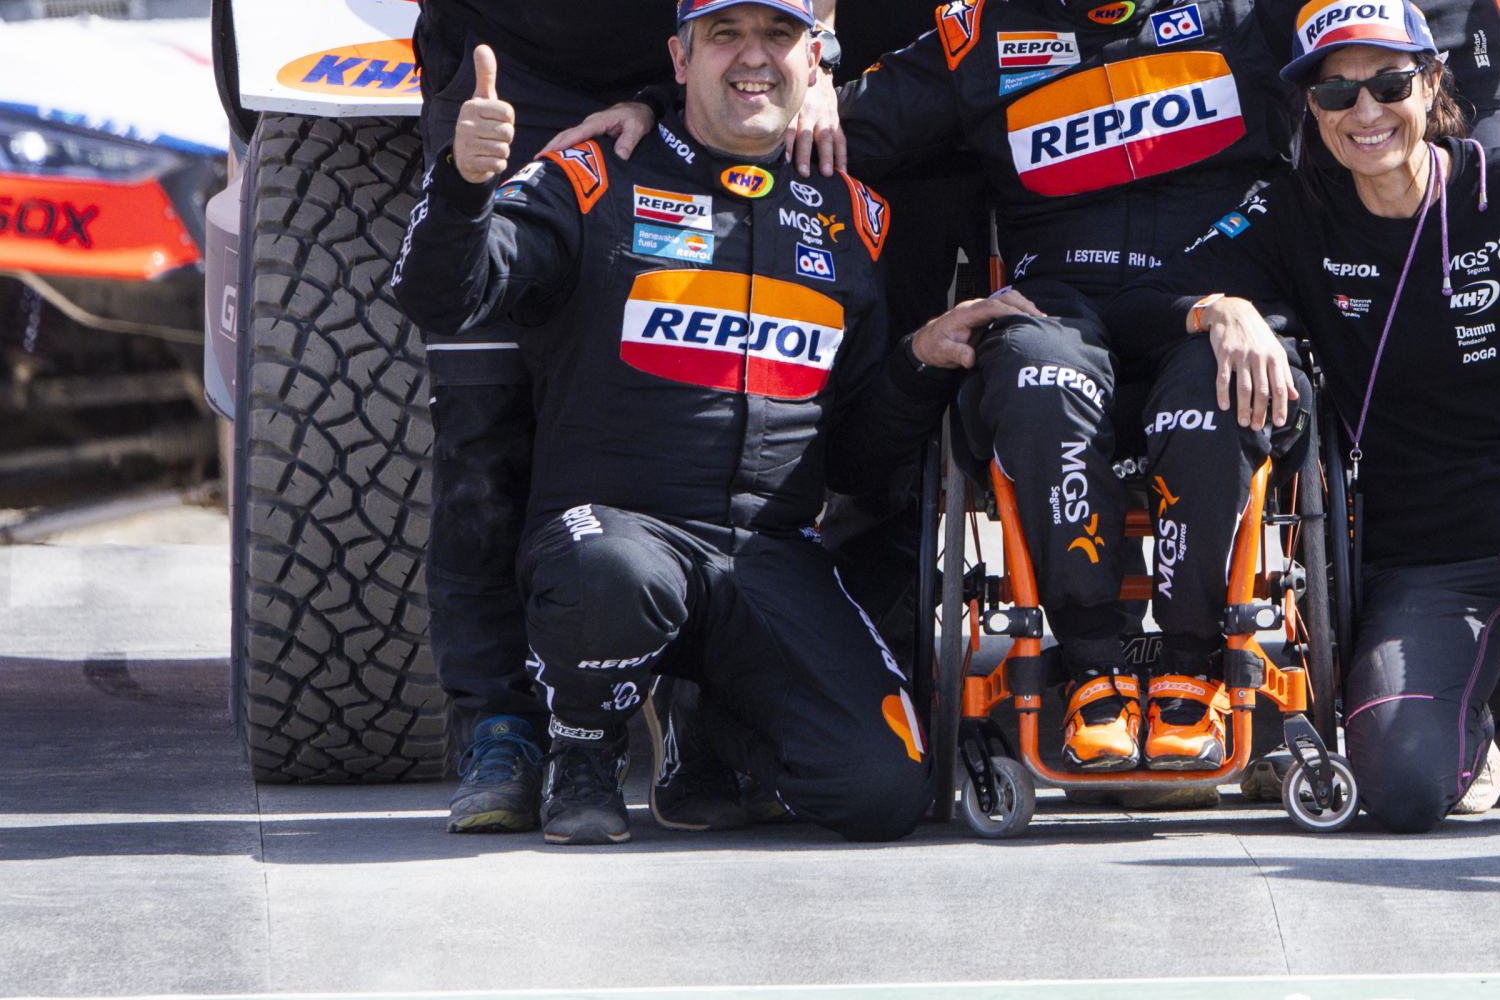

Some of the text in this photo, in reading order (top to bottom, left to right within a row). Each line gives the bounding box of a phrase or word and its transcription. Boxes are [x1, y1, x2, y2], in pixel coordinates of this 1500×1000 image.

[1306, 4, 1390, 45] REPSOL
[1003, 42, 1073, 54] REPSOL
[301, 54, 421, 93] KH-
[1030, 88, 1217, 164] REPSOL
[638, 196, 706, 217] REPSOL
[779, 208, 823, 237] MGS
[638, 239, 658, 249] fuels
[639, 230, 680, 244] Renewable
[677, 248, 711, 261] REPSOL
[1074, 250, 1120, 263] ESTEVE
[1129, 252, 1146, 267] RH
[1323, 257, 1380, 277] REPSOL
[1467, 266, 1490, 275] Seguros
[642, 307, 821, 363] REPSOL
[1455, 323, 1495, 339] Damm
[1458, 336, 1486, 347] Fundació
[1463, 347, 1496, 364] DOGA
[1018, 366, 1105, 408] REPSOL
[1145, 409, 1217, 435] PSOL
[1061, 441, 1090, 523] MGS
[1050, 486, 1061, 525] Seguros
[1177, 523, 1187, 561] Seguros
[1158, 518, 1178, 600] MGS
